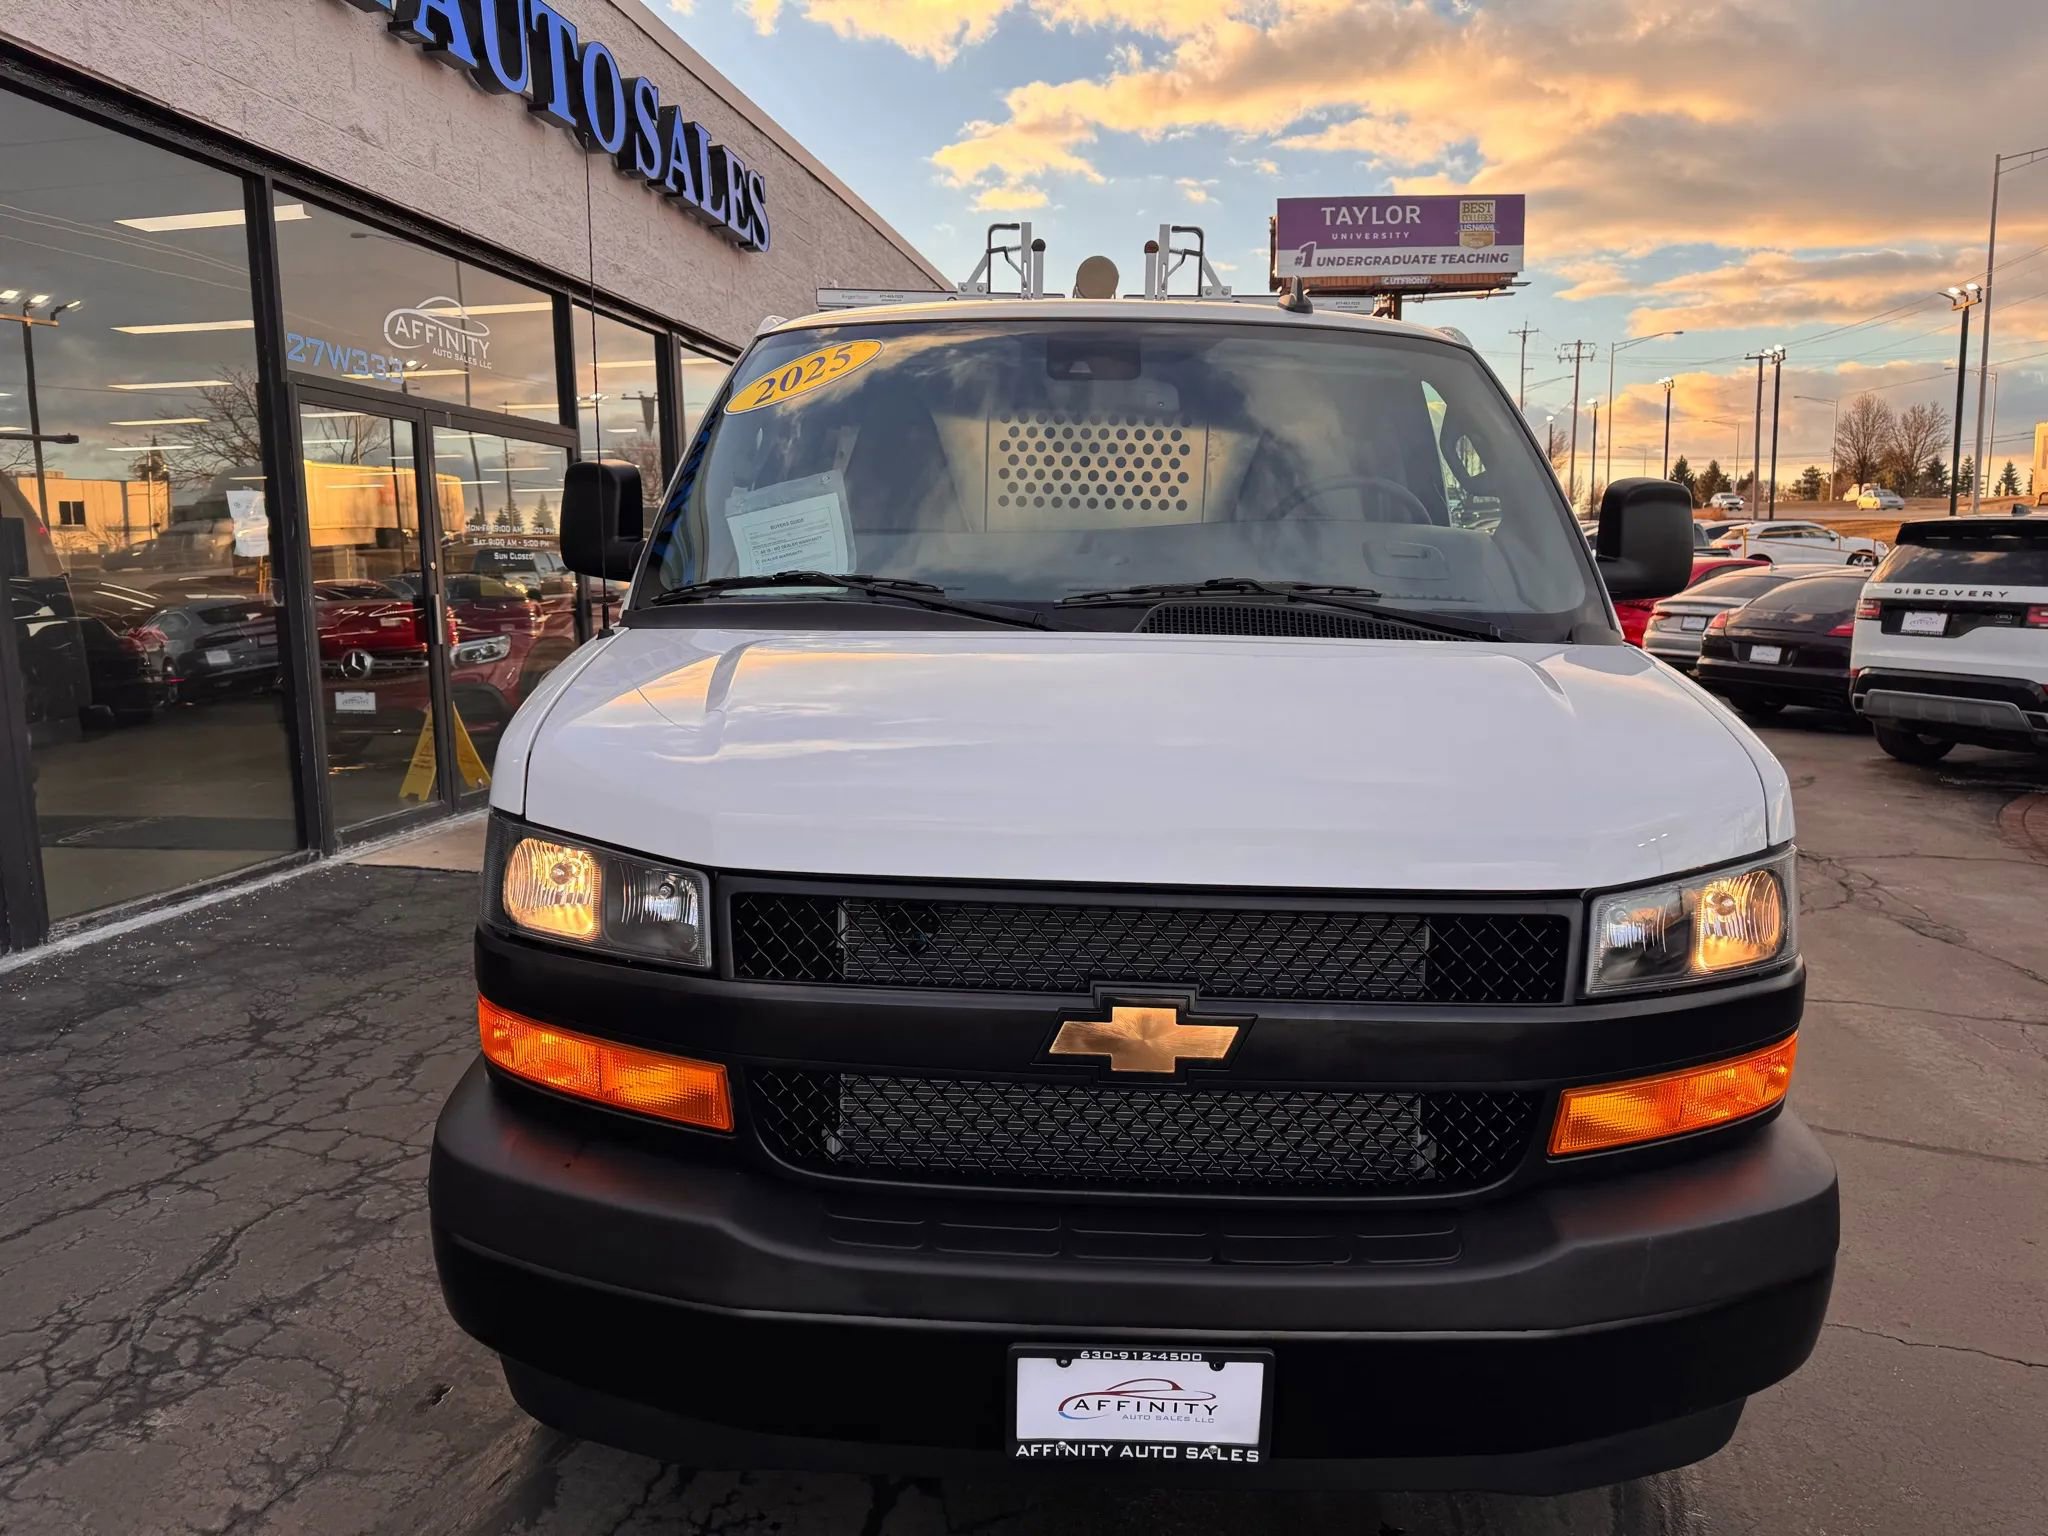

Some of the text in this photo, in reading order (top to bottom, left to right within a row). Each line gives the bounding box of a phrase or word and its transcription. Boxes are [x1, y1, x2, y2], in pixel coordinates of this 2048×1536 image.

[634, 76, 770, 252] SALES
[1321, 205, 1421, 226] TAYLOR
[1462, 202, 1493, 214] BEST
[1332, 231, 1410, 240] UNIVERSITY
[1295, 241, 1509, 268] #1 UNDERGRADUATE TEACHING
[395, 316, 490, 359] AFFINITY
[287, 332, 403, 384] 27W333
[432, 347, 492, 370] AUTO SALES LLC
[753, 344, 854, 406] 2025
[1894, 588, 2008, 598] DISCOVERY
[1080, 1351, 1202, 1361] 630-912-4500
[1074, 1399, 1219, 1415] AFFINITY
[1015, 1444, 1259, 1463] AFFINITY AUTO SALES
